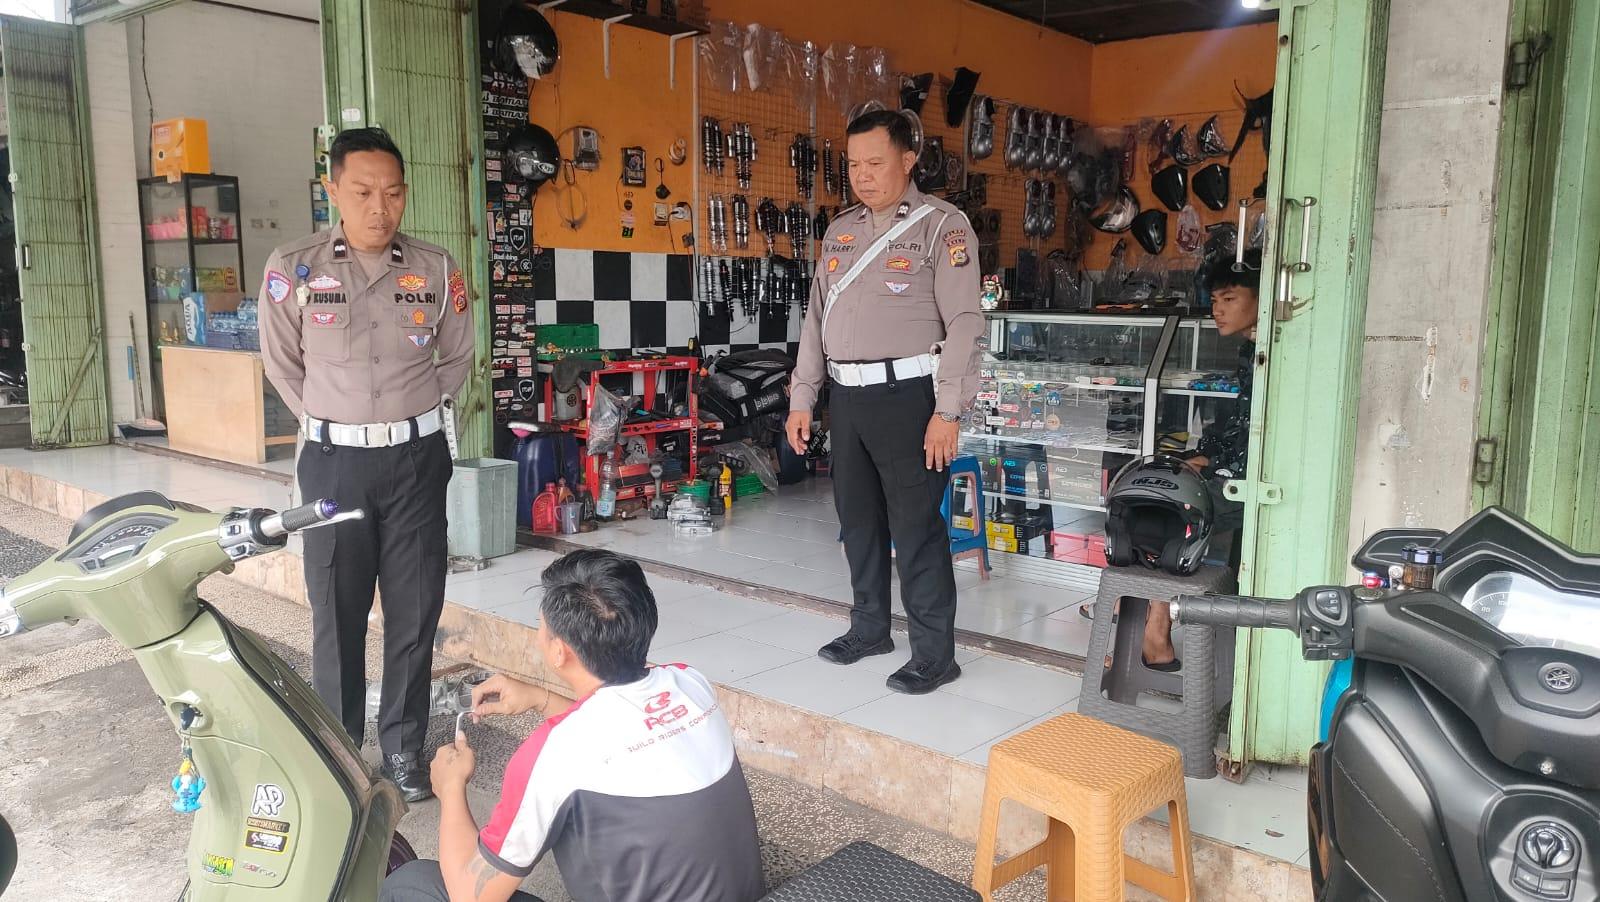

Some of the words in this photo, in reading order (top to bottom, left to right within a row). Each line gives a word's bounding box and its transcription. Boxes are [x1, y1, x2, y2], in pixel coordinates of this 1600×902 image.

[313, 292, 347, 305] KUSUMA
[394, 292, 436, 305] POLRI
[658, 726, 686, 741] RIDERS
